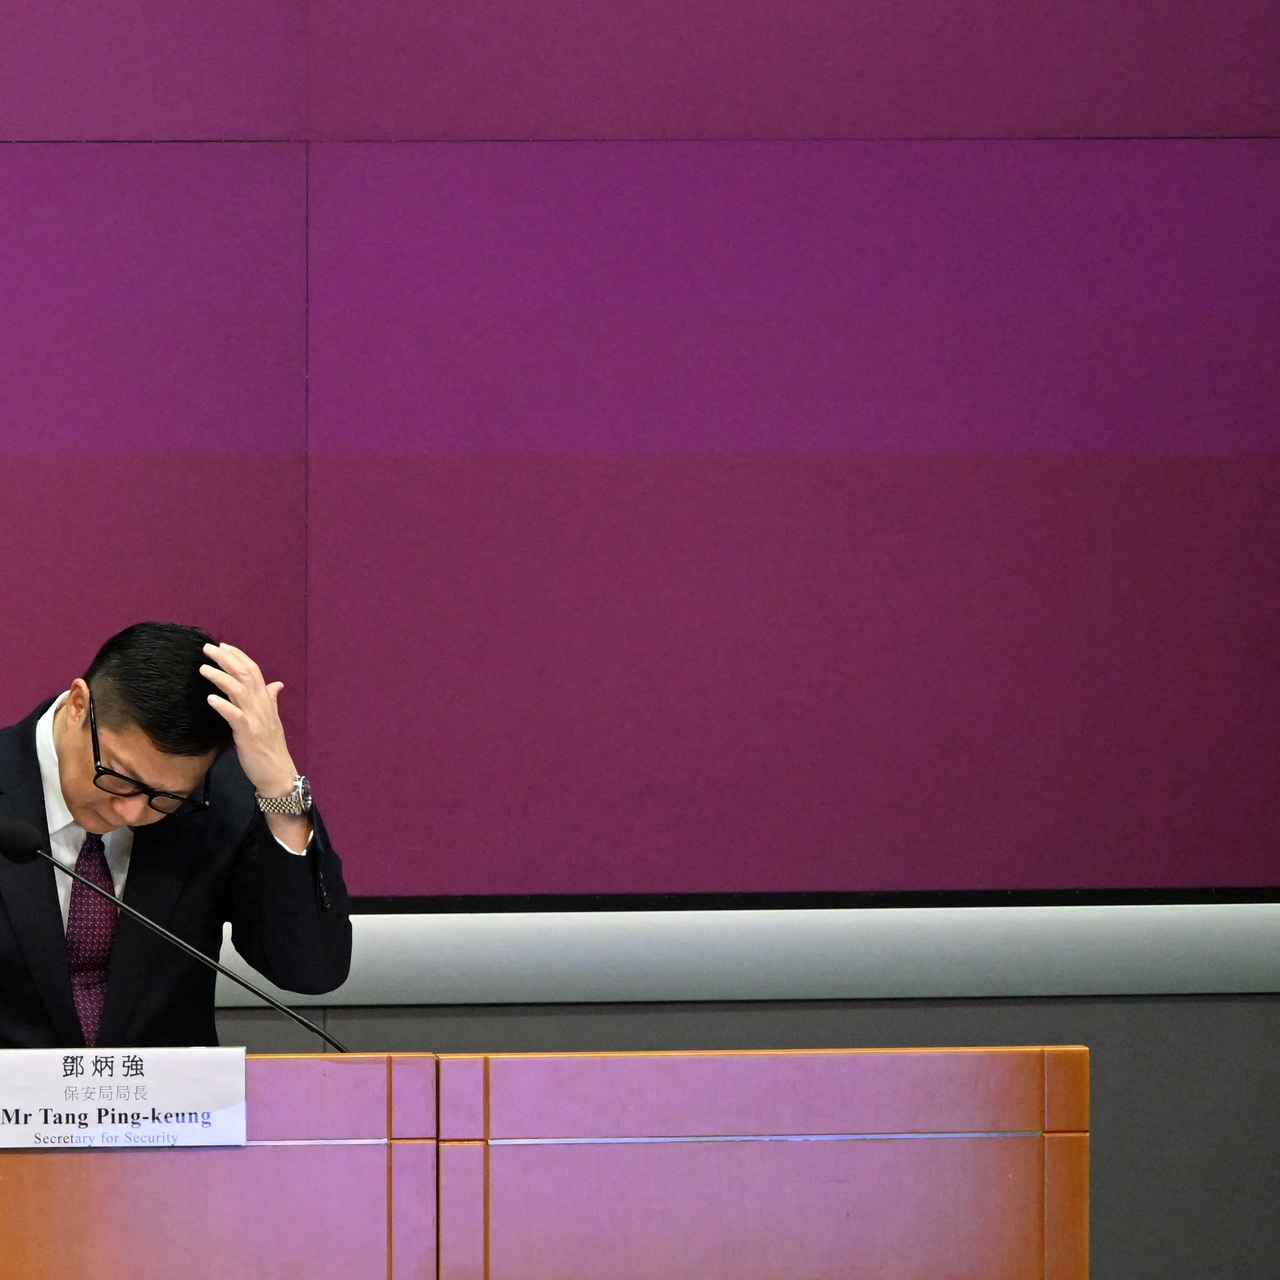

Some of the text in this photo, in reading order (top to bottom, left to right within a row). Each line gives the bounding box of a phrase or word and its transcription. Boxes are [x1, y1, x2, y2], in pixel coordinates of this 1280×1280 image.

[62, 1054, 145, 1078] 鄧炳強
[63, 1085, 148, 1102] 保安局局長
[1, 1107, 212, 1129] Mr Tang Ping-keung
[33, 1132, 180, 1147] Secretary for Security
